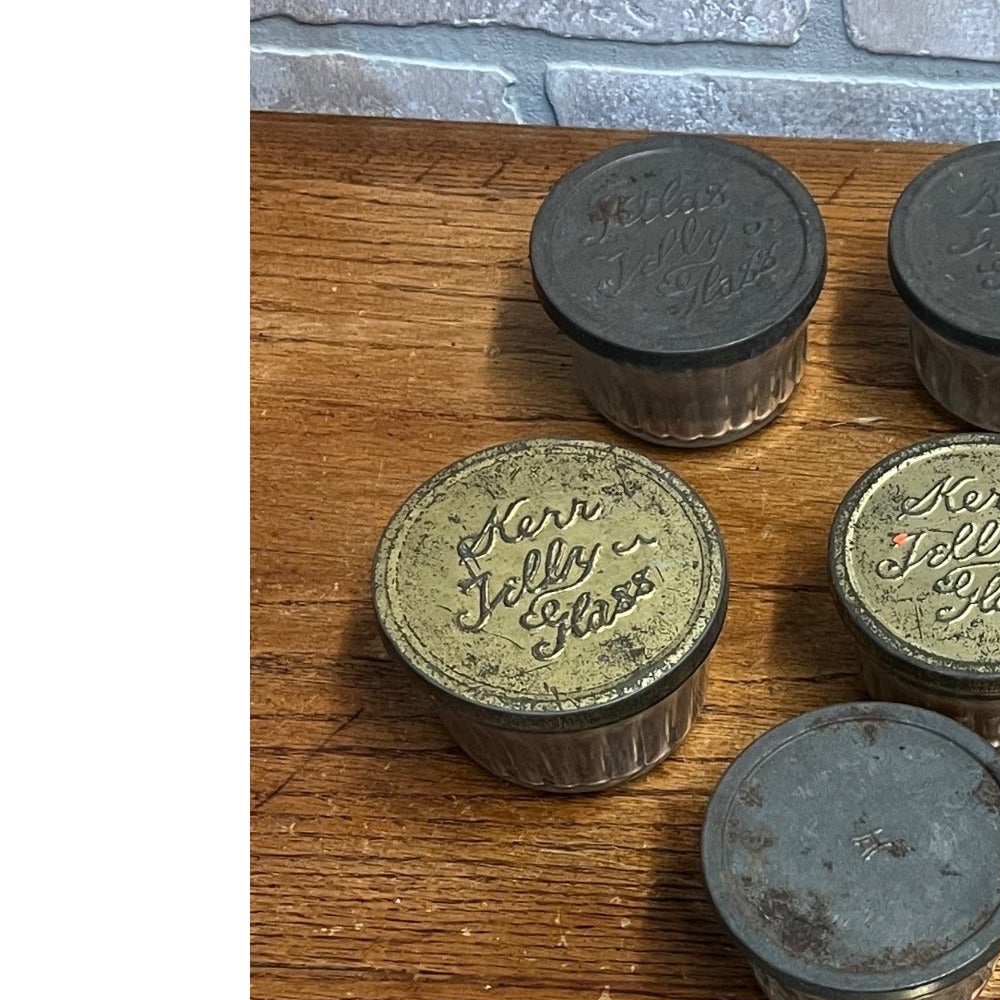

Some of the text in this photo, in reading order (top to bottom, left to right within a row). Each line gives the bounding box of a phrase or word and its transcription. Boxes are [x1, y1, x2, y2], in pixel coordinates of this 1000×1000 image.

[597, 217, 728, 298] Jelly
[656, 241, 780, 320] Glass
[456, 497, 603, 565] Kerr
[456, 537, 602, 633] Jelly
[518, 566, 657, 662] Glass
